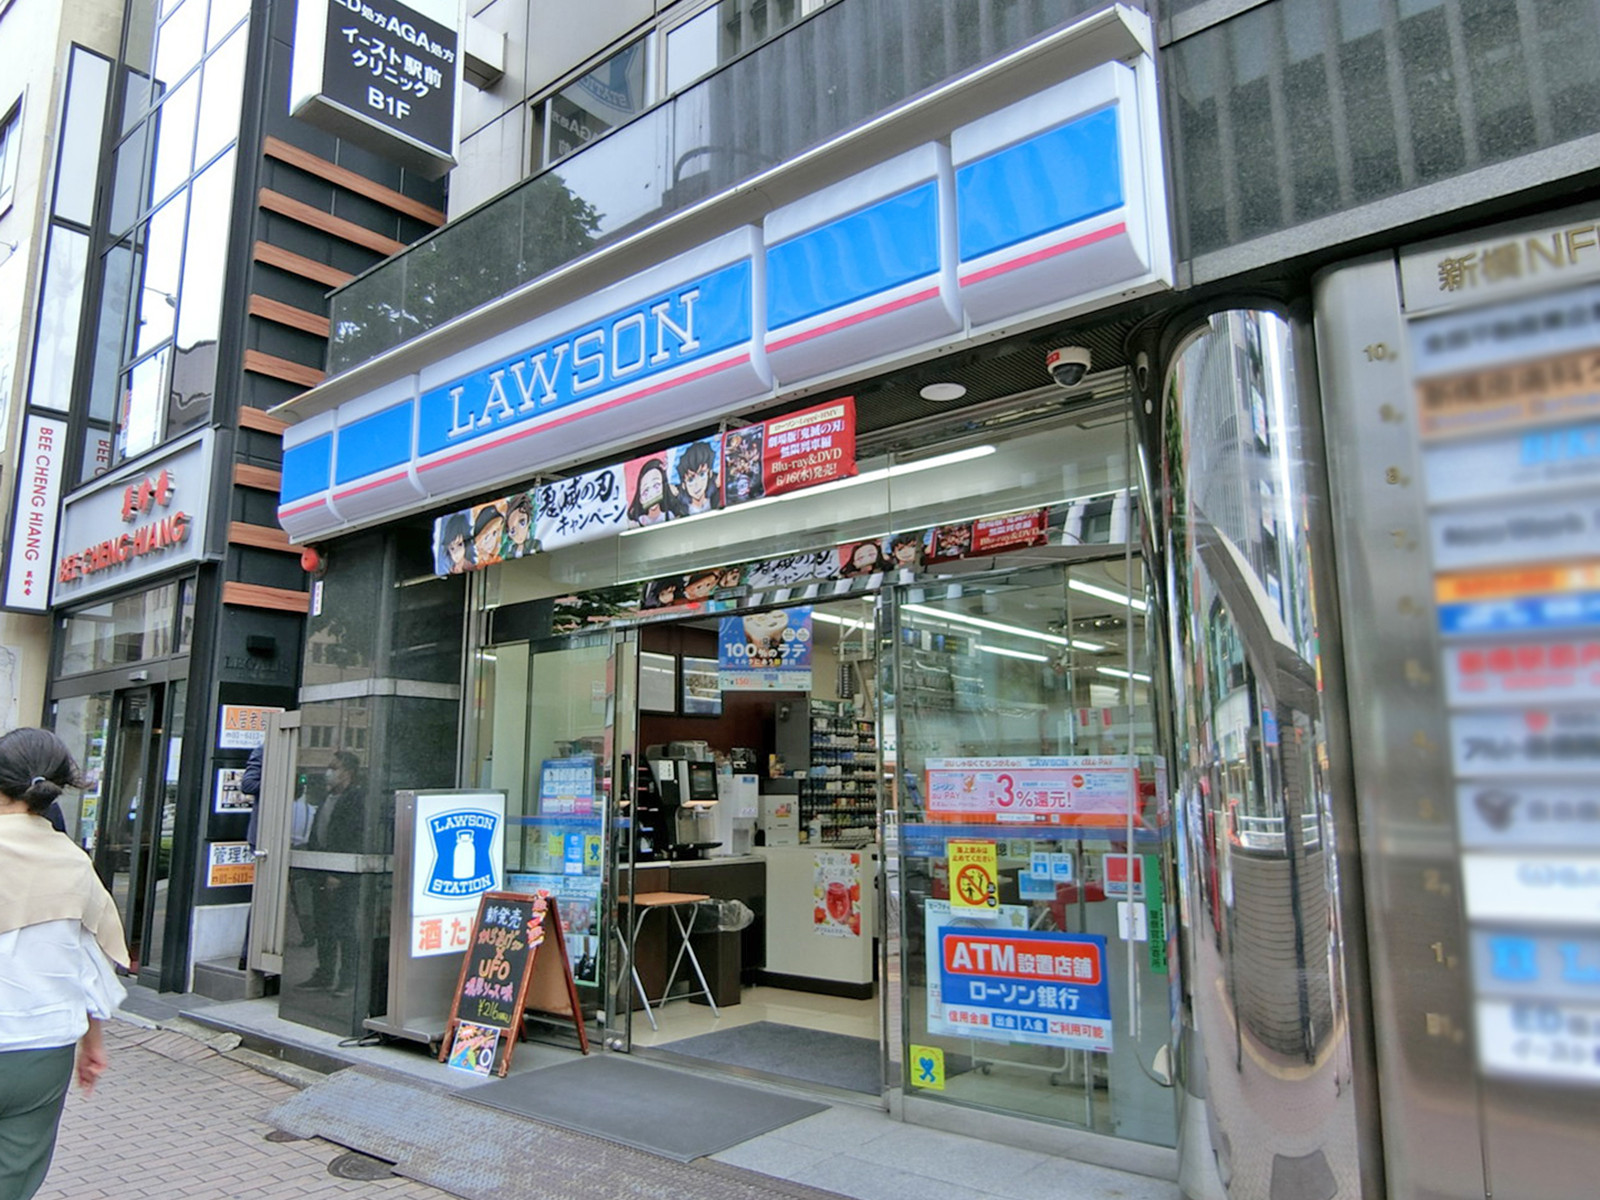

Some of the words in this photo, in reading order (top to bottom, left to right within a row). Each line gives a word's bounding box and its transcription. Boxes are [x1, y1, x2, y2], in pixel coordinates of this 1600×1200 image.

[341, 27, 442, 89] イースト駅前
[352, 49, 429, 98] クリニック
[368, 85, 411, 119] B1F
[1438, 224, 1600, 292] 新NF
[448, 289, 700, 438] LAWSON
[38, 426, 53, 451] BEE
[771, 447, 842, 474] Blu-ray&DVD
[31, 455, 50, 508] CHENG
[536, 470, 619, 522] 「鬼滅の刃」
[25, 511, 43, 561] HIANG
[556, 504, 627, 536] キャンペーン
[725, 643, 806, 658] 100%のラテ
[434, 815, 494, 833] LAWSON
[432, 874, 492, 894] STATION
[1108, 882, 1142, 891] SECM
[418, 916, 474, 951] 酒・た
[485, 906, 522, 929] 新発売
[479, 959, 511, 981] UFO
[952, 942, 1093, 979] ATM設置店舗
[969, 980, 1080, 1011] ローソン銀行
[948, 1010, 989, 1025] 信用金庫
[994, 1016, 1015, 1028] 出金
[1023, 1018, 1044, 1031] 入金
[1050, 1021, 1104, 1039] ご利用可能
